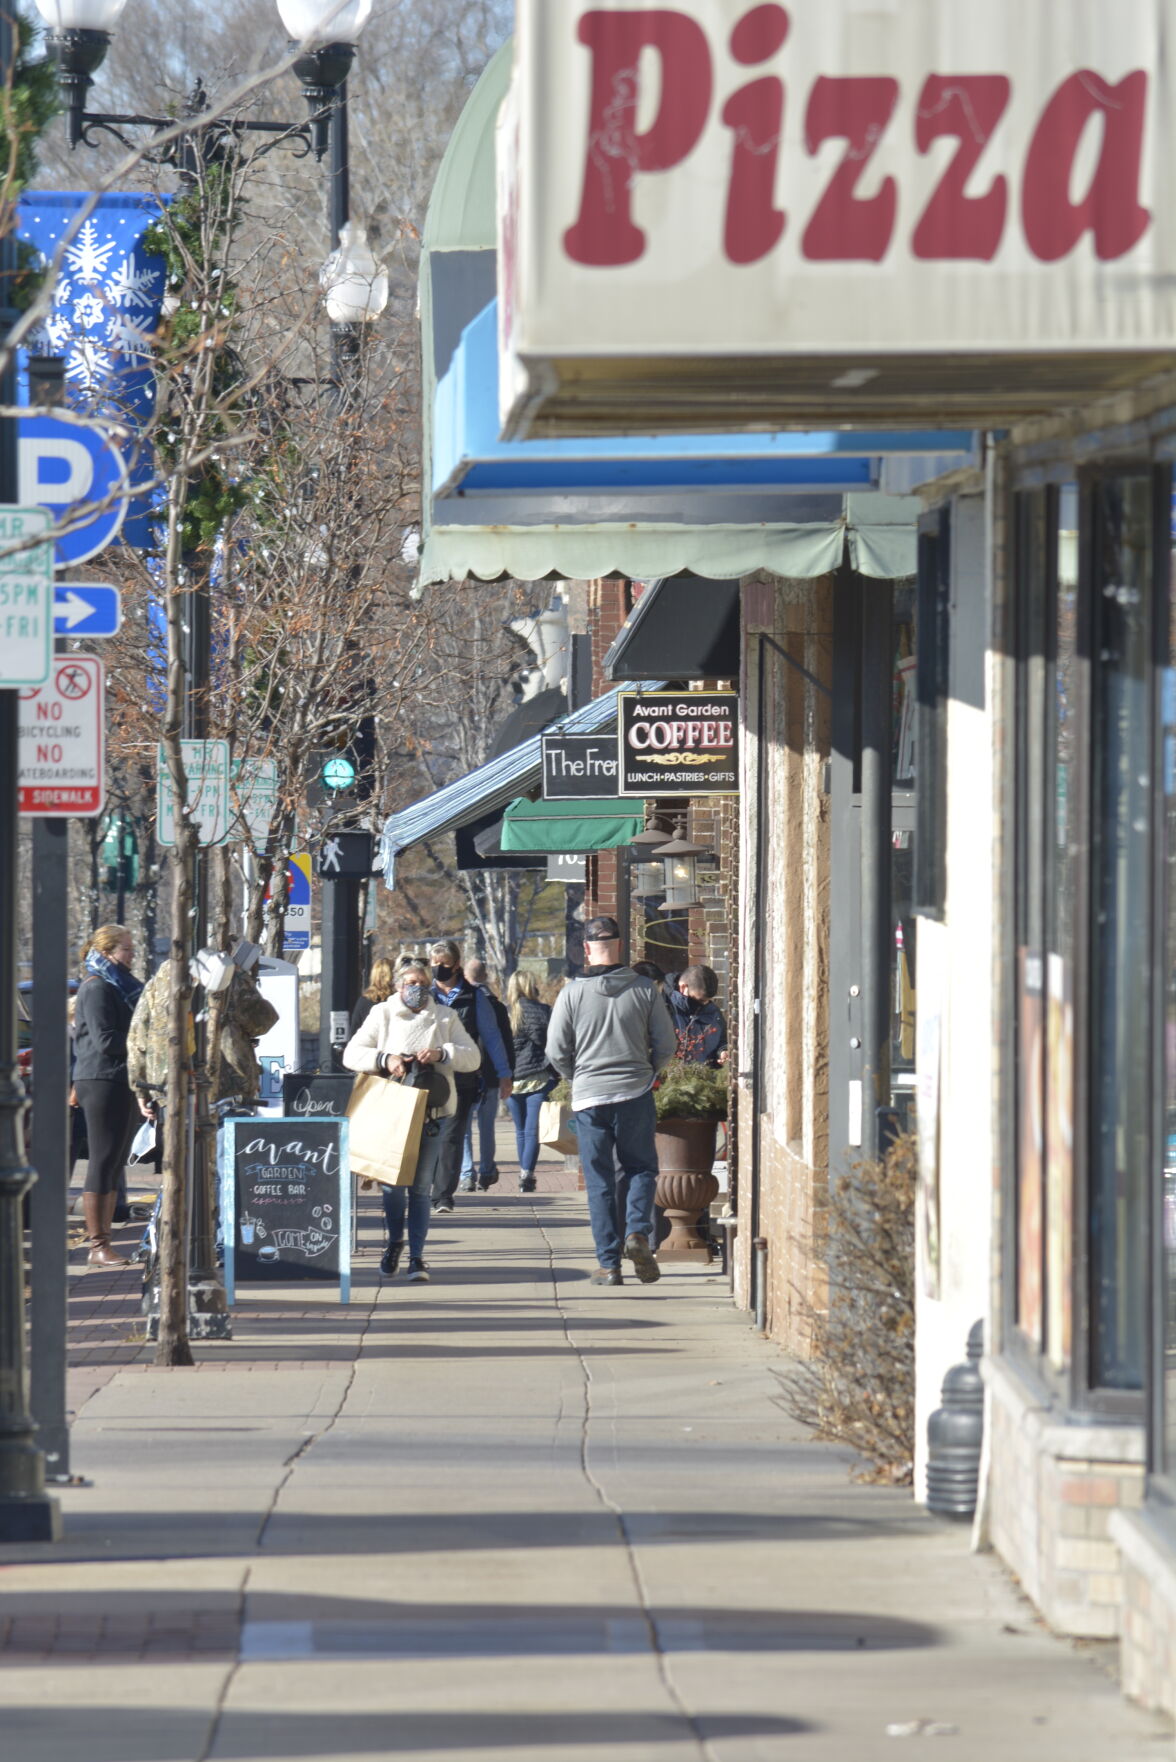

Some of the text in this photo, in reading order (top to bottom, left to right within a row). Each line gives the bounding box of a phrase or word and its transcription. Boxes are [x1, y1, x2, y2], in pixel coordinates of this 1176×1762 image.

[563, 3, 1151, 267] Pizza
[18, 438, 93, 506] P
[36, 702, 62, 721] NO
[632, 703, 729, 717] Avant Garden
[628, 721, 734, 750] COFFEE
[36, 744, 63, 764] NO
[546, 749, 584, 777] The
[32, 790, 93, 804] SIDEWALK
[293, 1086, 342, 1117] Open
[235, 1137, 340, 1176] avant
[260, 1167, 303, 1179] GARDEN
[253, 1184, 306, 1196] COFFEE BAR
[278, 1231, 323, 1250] COME ON
